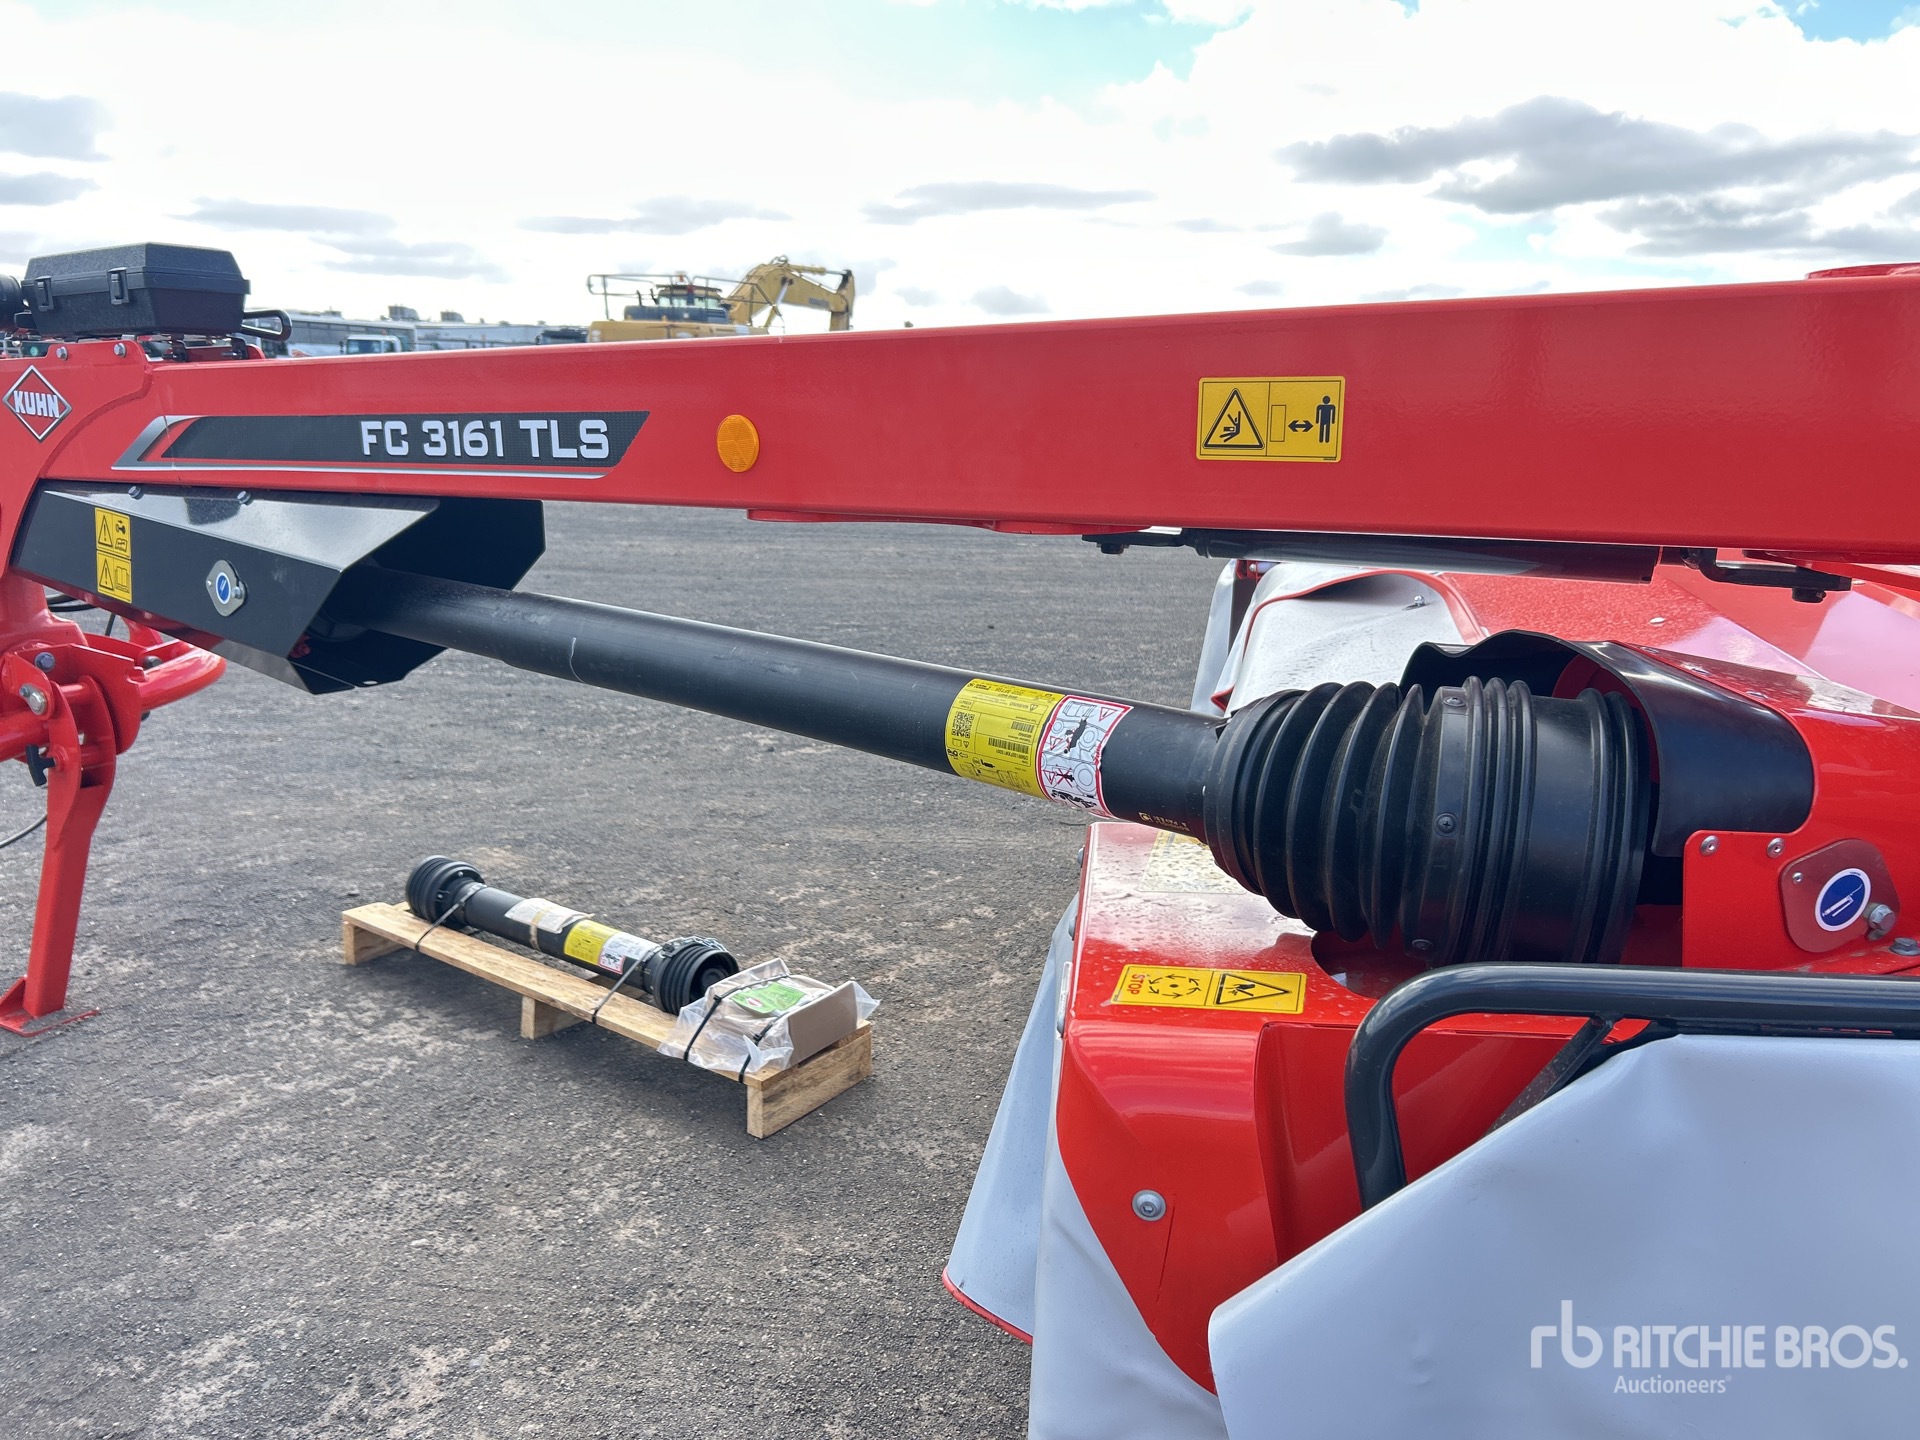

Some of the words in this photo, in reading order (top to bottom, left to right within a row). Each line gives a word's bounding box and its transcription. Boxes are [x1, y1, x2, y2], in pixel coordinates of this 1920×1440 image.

[13, 390, 61, 418] KUHN
[360, 420, 409, 456] FC
[421, 420, 504, 457] 3161
[518, 419, 610, 459] TLS
[1127, 973, 1146, 995] STOP
